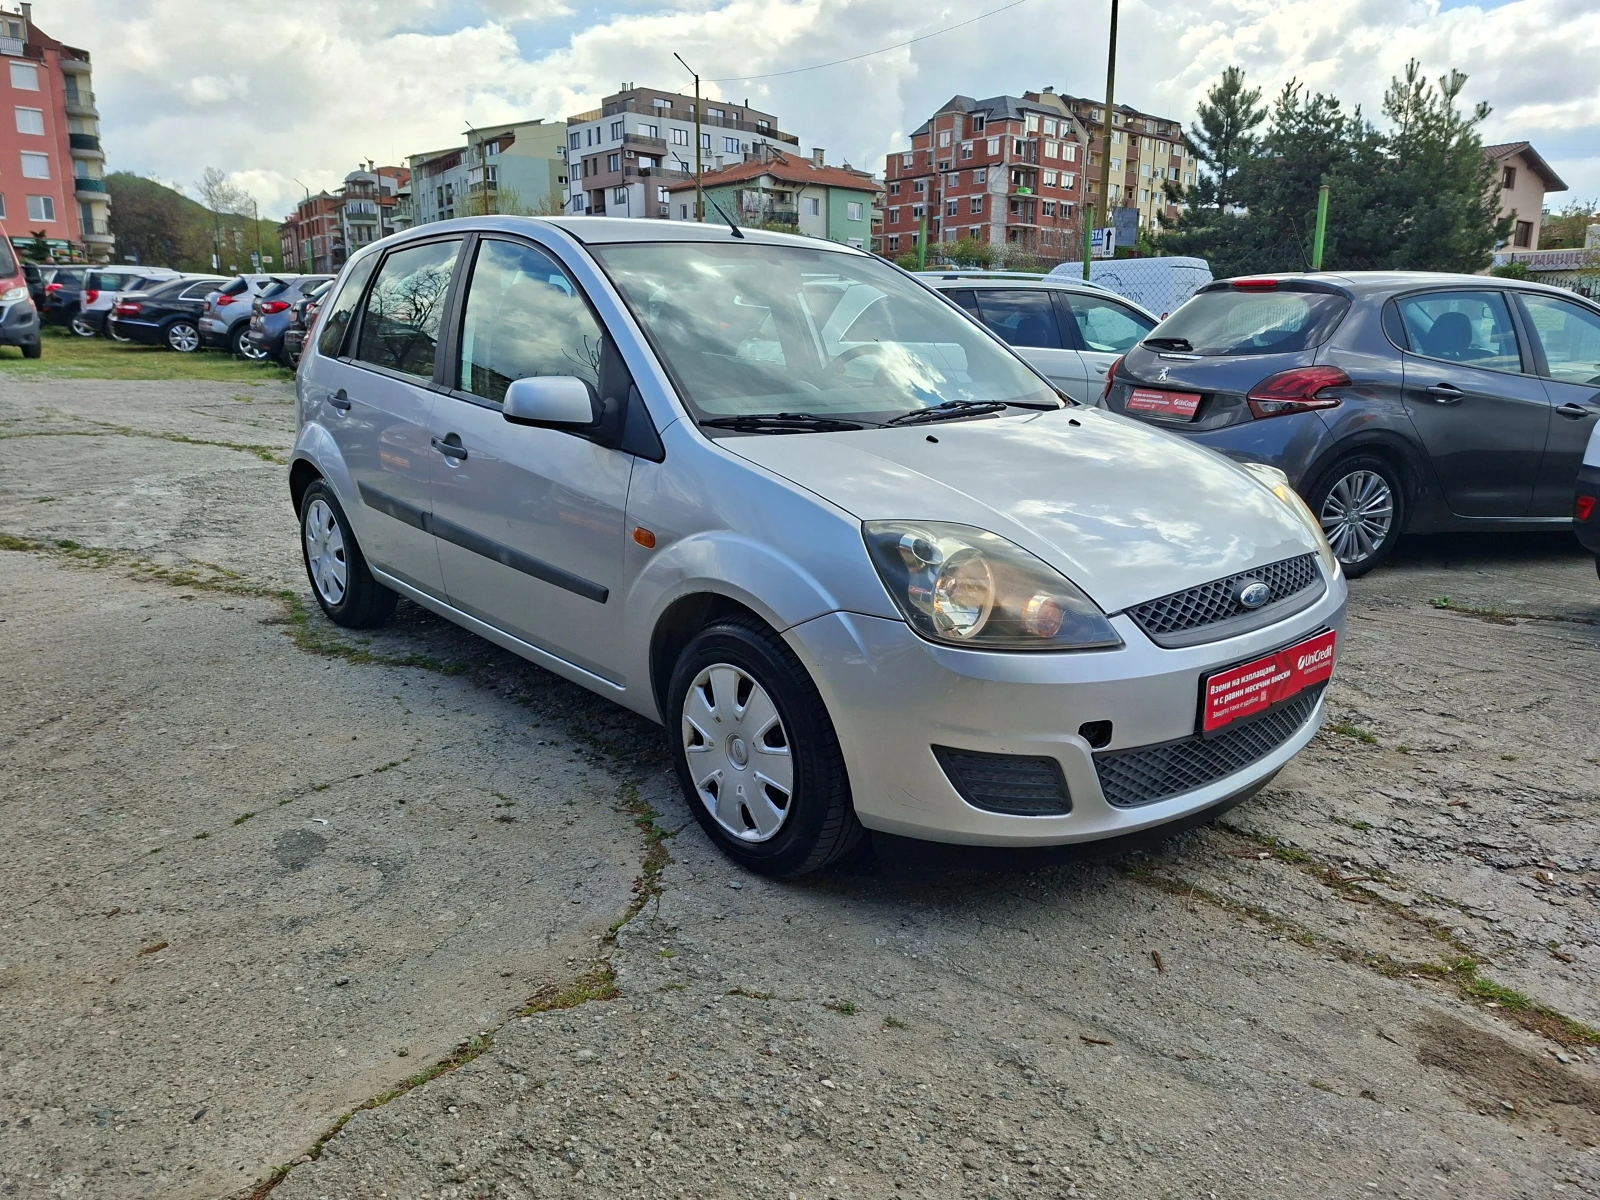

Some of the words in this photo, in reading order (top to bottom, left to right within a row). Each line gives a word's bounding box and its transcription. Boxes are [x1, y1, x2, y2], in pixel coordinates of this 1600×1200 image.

[1305, 644, 1333, 666] UniCredit
[1210, 681, 1231, 695] Вземи
[1231, 678, 1240, 687] на
[1240, 664, 1276, 684] изплащане
[1213, 698, 1219, 706] и
[1219, 696, 1224, 704] с
[1224, 688, 1244, 704] равни
[1244, 679, 1271, 694] месечни
[1271, 670, 1291, 684] вноски
